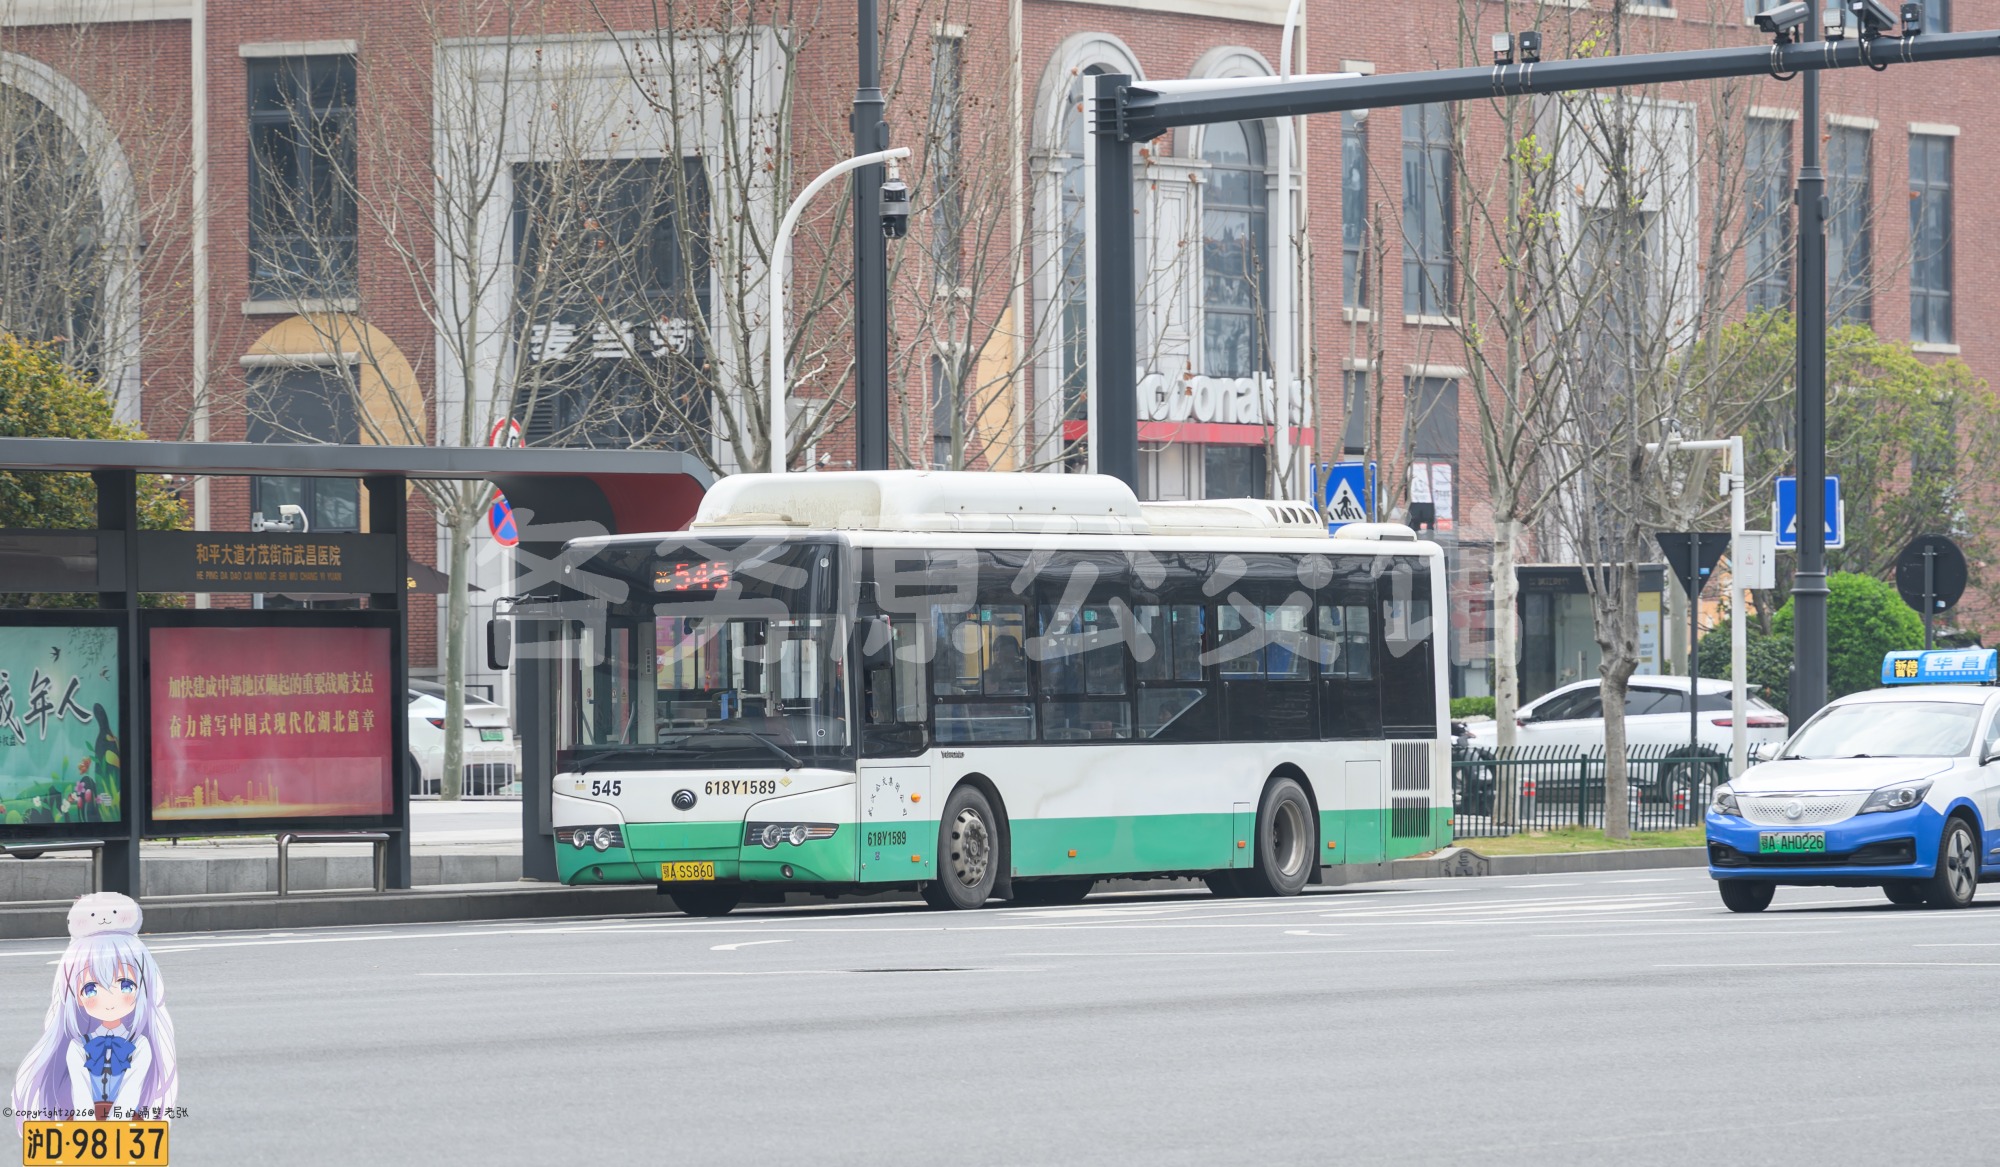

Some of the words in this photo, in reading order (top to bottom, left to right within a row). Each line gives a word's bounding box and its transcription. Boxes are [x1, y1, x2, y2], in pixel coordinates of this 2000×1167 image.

[196, 544, 342, 566] 和平大道才茂街市武昌医院
[675, 563, 729, 590] 545
[1895, 659, 1918, 678] 暂停
[1933, 656, 1980, 669] 华昌
[168, 671, 374, 699] 加快建成中部地区崛起的重要战略支点
[169, 709, 375, 738] 奋力谱写中国式现代化湖北篇章
[591, 780, 622, 797] 545
[704, 780, 776, 796] 618Y1589
[867, 831, 907, 847] 618Y1589
